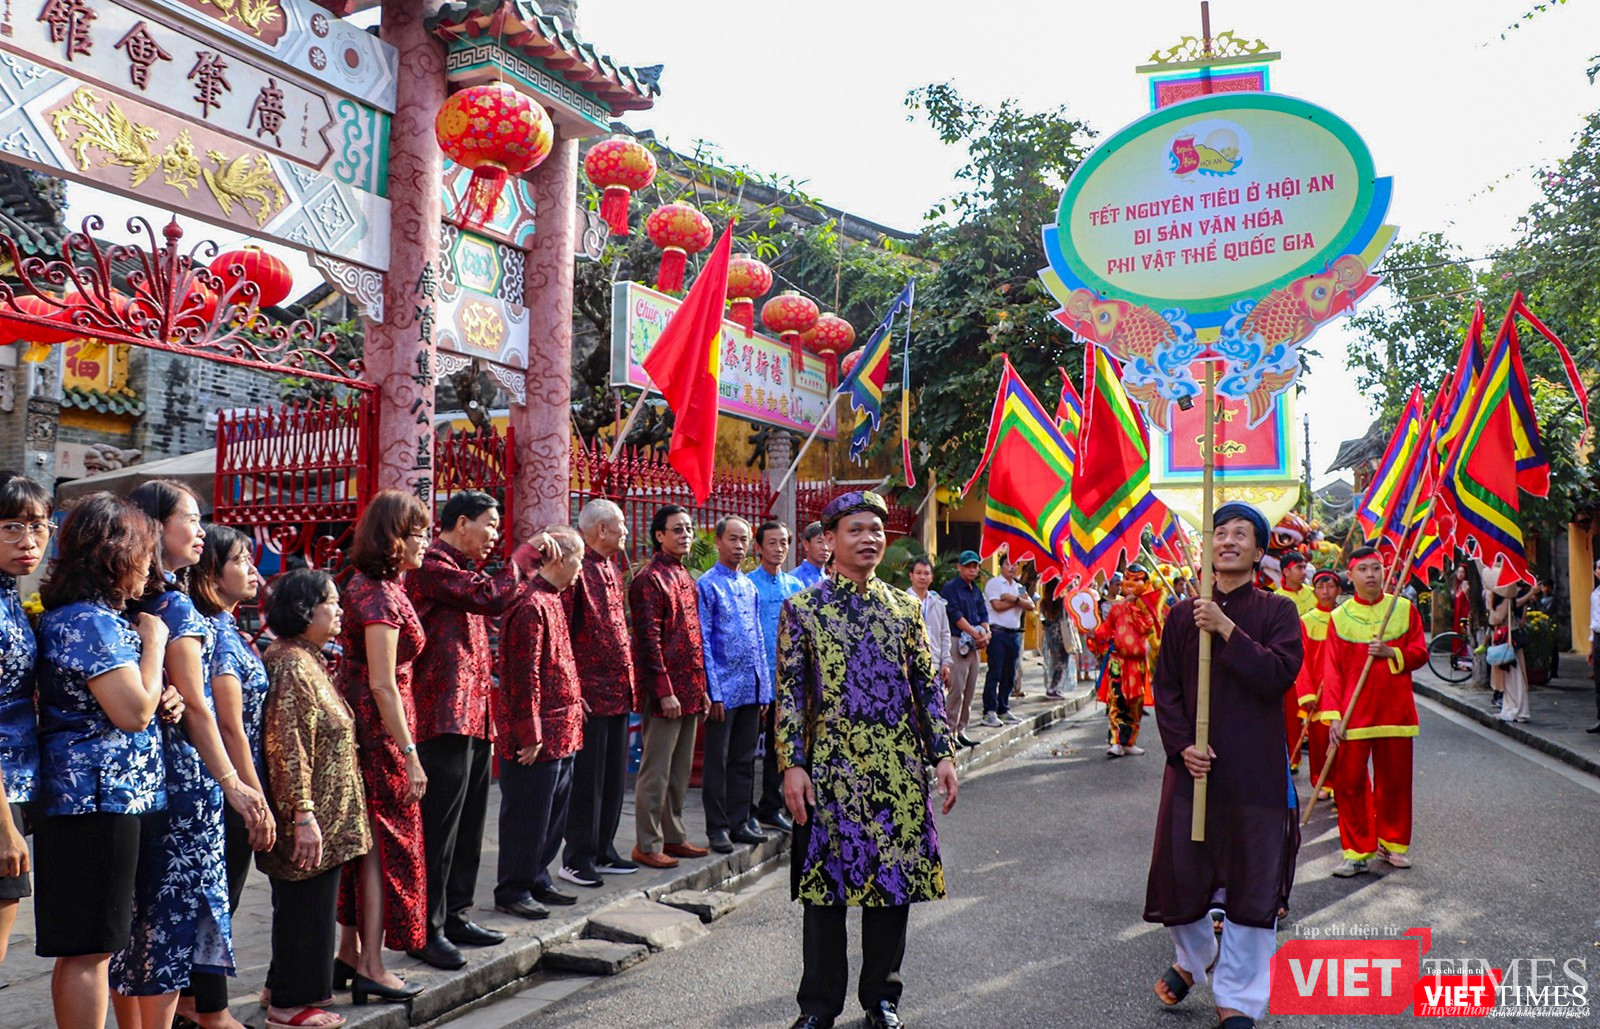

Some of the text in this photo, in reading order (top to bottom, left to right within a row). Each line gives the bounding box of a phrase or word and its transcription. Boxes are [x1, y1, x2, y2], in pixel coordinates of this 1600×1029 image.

[1089, 174, 1335, 226] TẾT NGUYÊN TIÊU Ở HỘI AN
[1134, 207, 1284, 246] DI SẢN VĂN HÓA
[1107, 232, 1315, 275] PHI VẬT THỂ QUỐC GIA
[743, 383, 789, 418] 萬事如意
